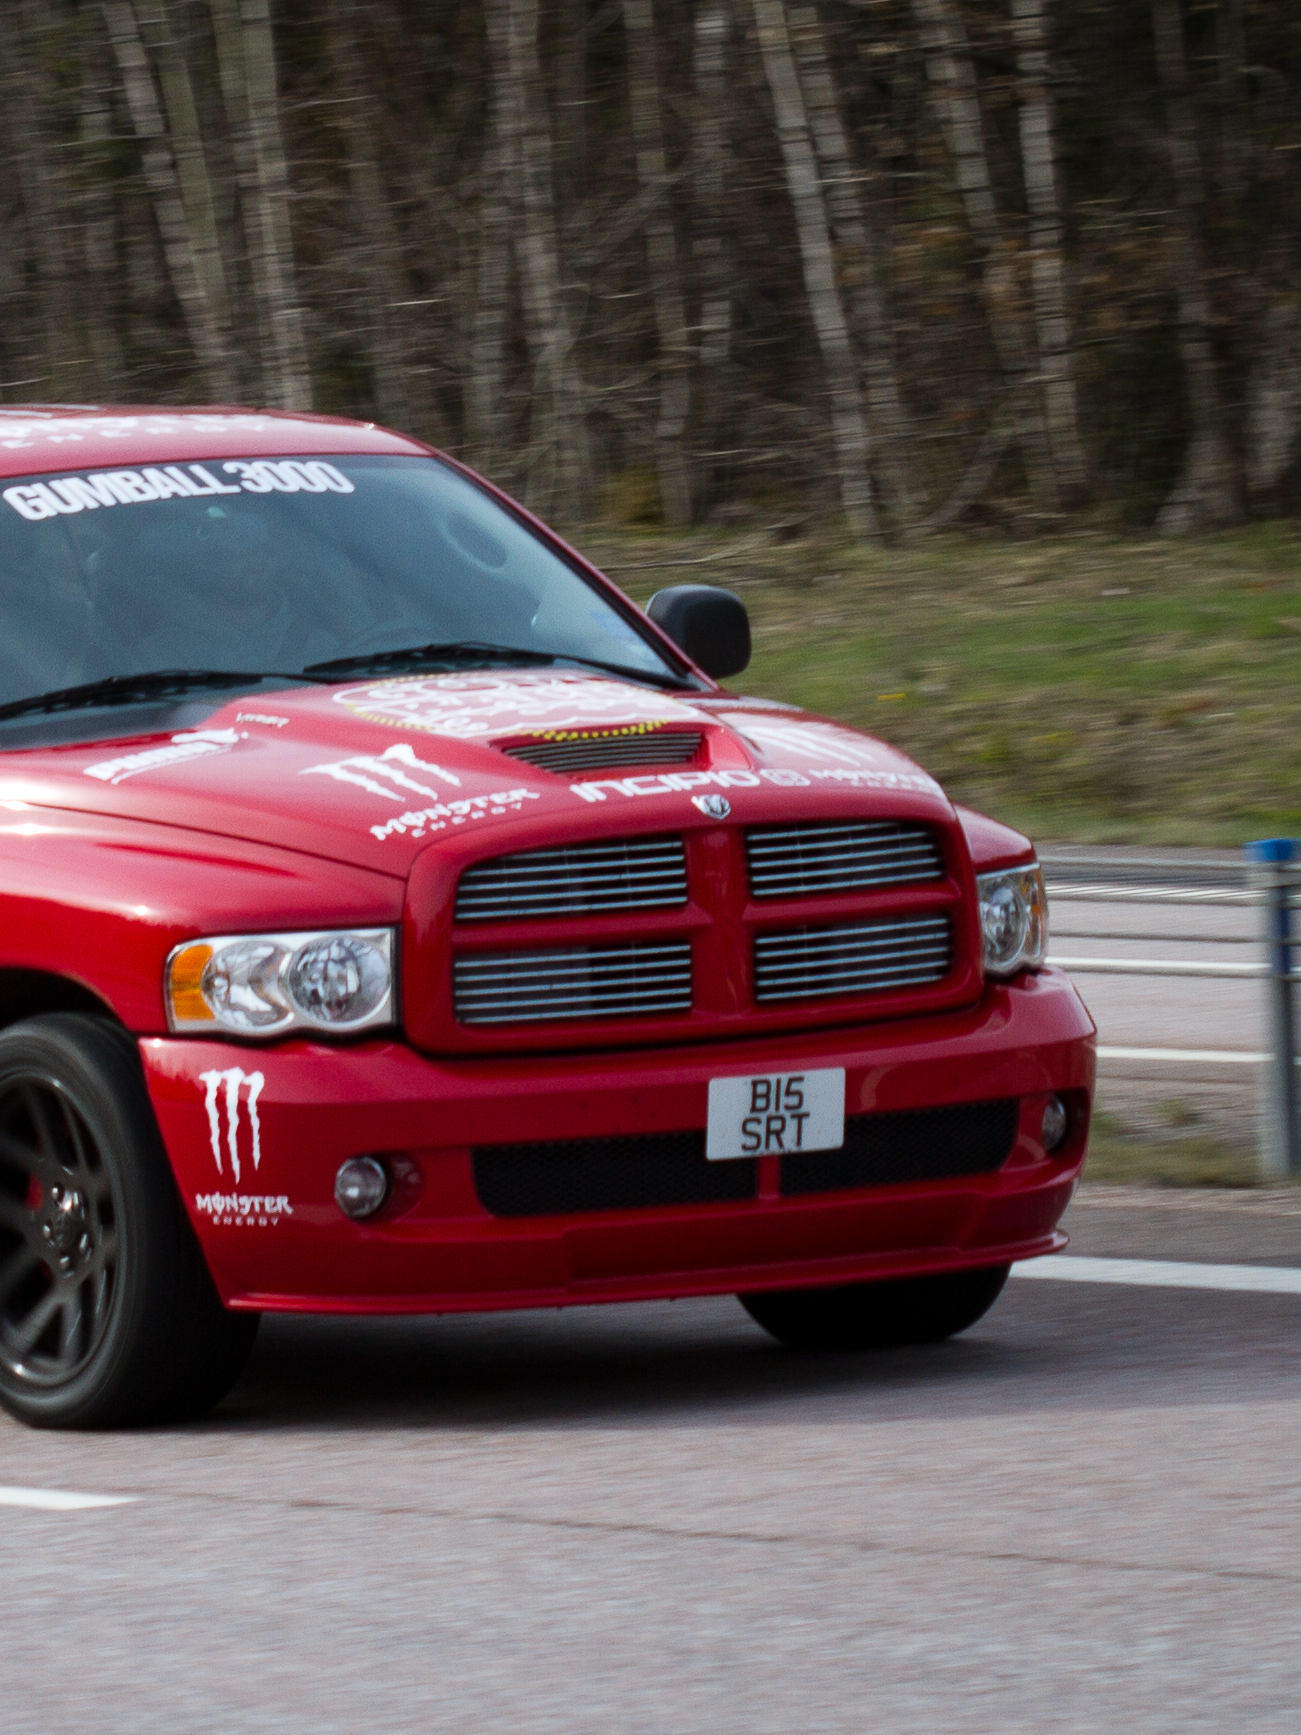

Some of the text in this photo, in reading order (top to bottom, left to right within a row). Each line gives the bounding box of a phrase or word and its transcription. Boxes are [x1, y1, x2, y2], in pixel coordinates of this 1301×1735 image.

[2, 460, 355, 521] GUMBALL 3000
[569, 770, 761, 802] INCIPIO
[370, 788, 541, 841] MONSTER
[741, 1112, 811, 1151] SRT
[195, 1191, 294, 1215] MONSTER
